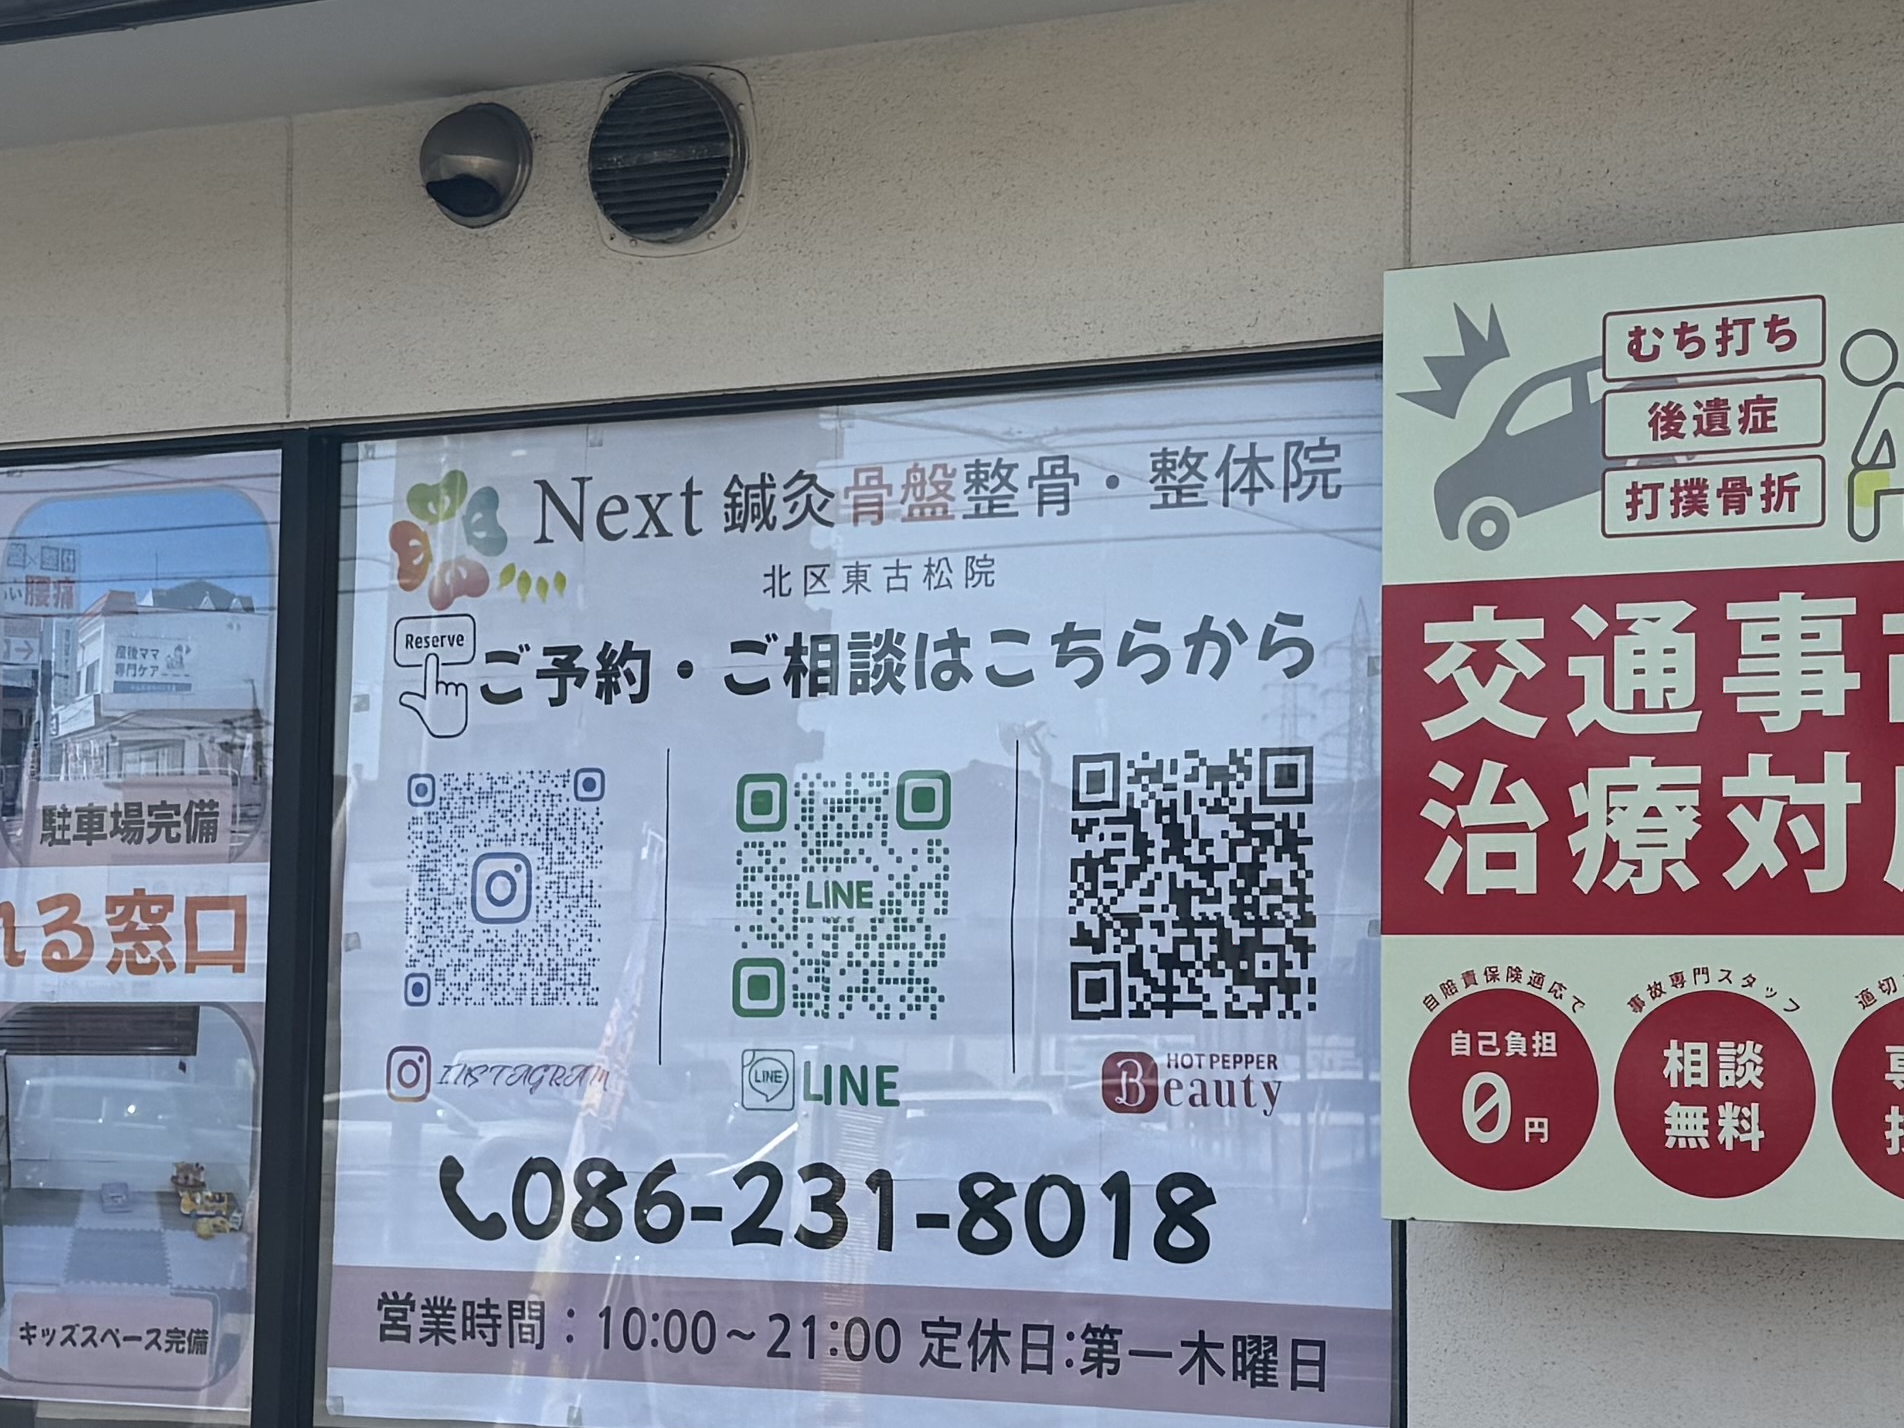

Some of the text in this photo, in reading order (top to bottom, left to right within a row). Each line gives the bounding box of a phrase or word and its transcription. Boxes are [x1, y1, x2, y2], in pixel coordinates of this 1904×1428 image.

[1627, 314, 1798, 362] むち打ち
[1647, 393, 1778, 442] 後遺症
[533, 435, 1342, 545] Next 鍼灸骨盤整骨・整体院
[1625, 471, 1801, 523] 打撲骨折
[762, 553, 997, 599] 北区東古松院
[404, 633, 465, 650] Reserve
[479, 610, 1316, 708] ご予約・ご相談はこちらから
[39, 800, 221, 847] 駐車場完備
[806, 880, 874, 910] LINE
[1421, 965, 1586, 1014] 自賠責保険適応で
[1626, 966, 1801, 1014] 事故専門スタッフ
[1166, 1053, 1279, 1070] HOT PEPPER
[1450, 1031, 1558, 1058] 自己負担
[1662, 1039, 1765, 1090] 相談
[436, 1062, 611, 1096] INSTAGRAM
[754, 1069, 784, 1084] LINE
[802, 1060, 901, 1108] LINE
[1462, 1071, 1549, 1144] 0円
[1663, 1100, 1766, 1152] 無料
[511, 1156, 1218, 1264] 086-231-8018
[17, 1321, 210, 1358] キッズスペース完備
